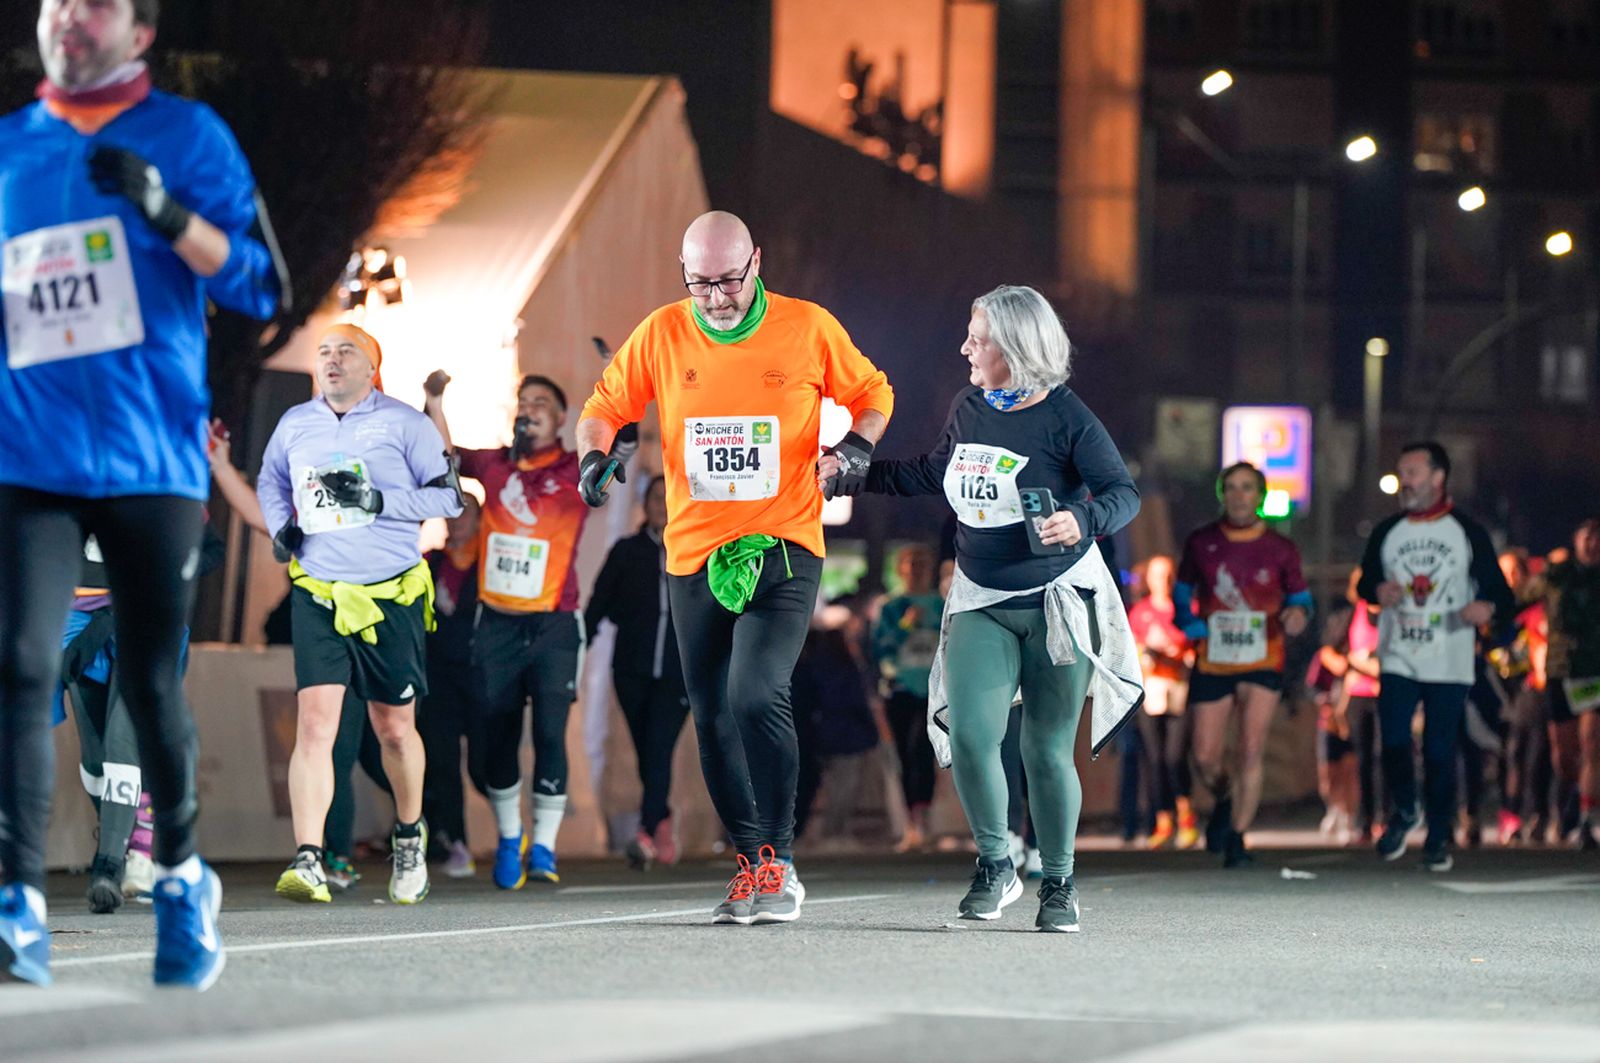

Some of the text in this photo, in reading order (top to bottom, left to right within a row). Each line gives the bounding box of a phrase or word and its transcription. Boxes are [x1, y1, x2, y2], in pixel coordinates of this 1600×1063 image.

[28, 272, 101, 313] 4121
[695, 437, 712, 446] SAN
[714, 434, 745, 445] ANTÓN
[704, 426, 744, 434] NOCHE DE
[703, 447, 760, 472] 1354
[961, 475, 998, 501] 1125
[497, 556, 530, 575] 4014
